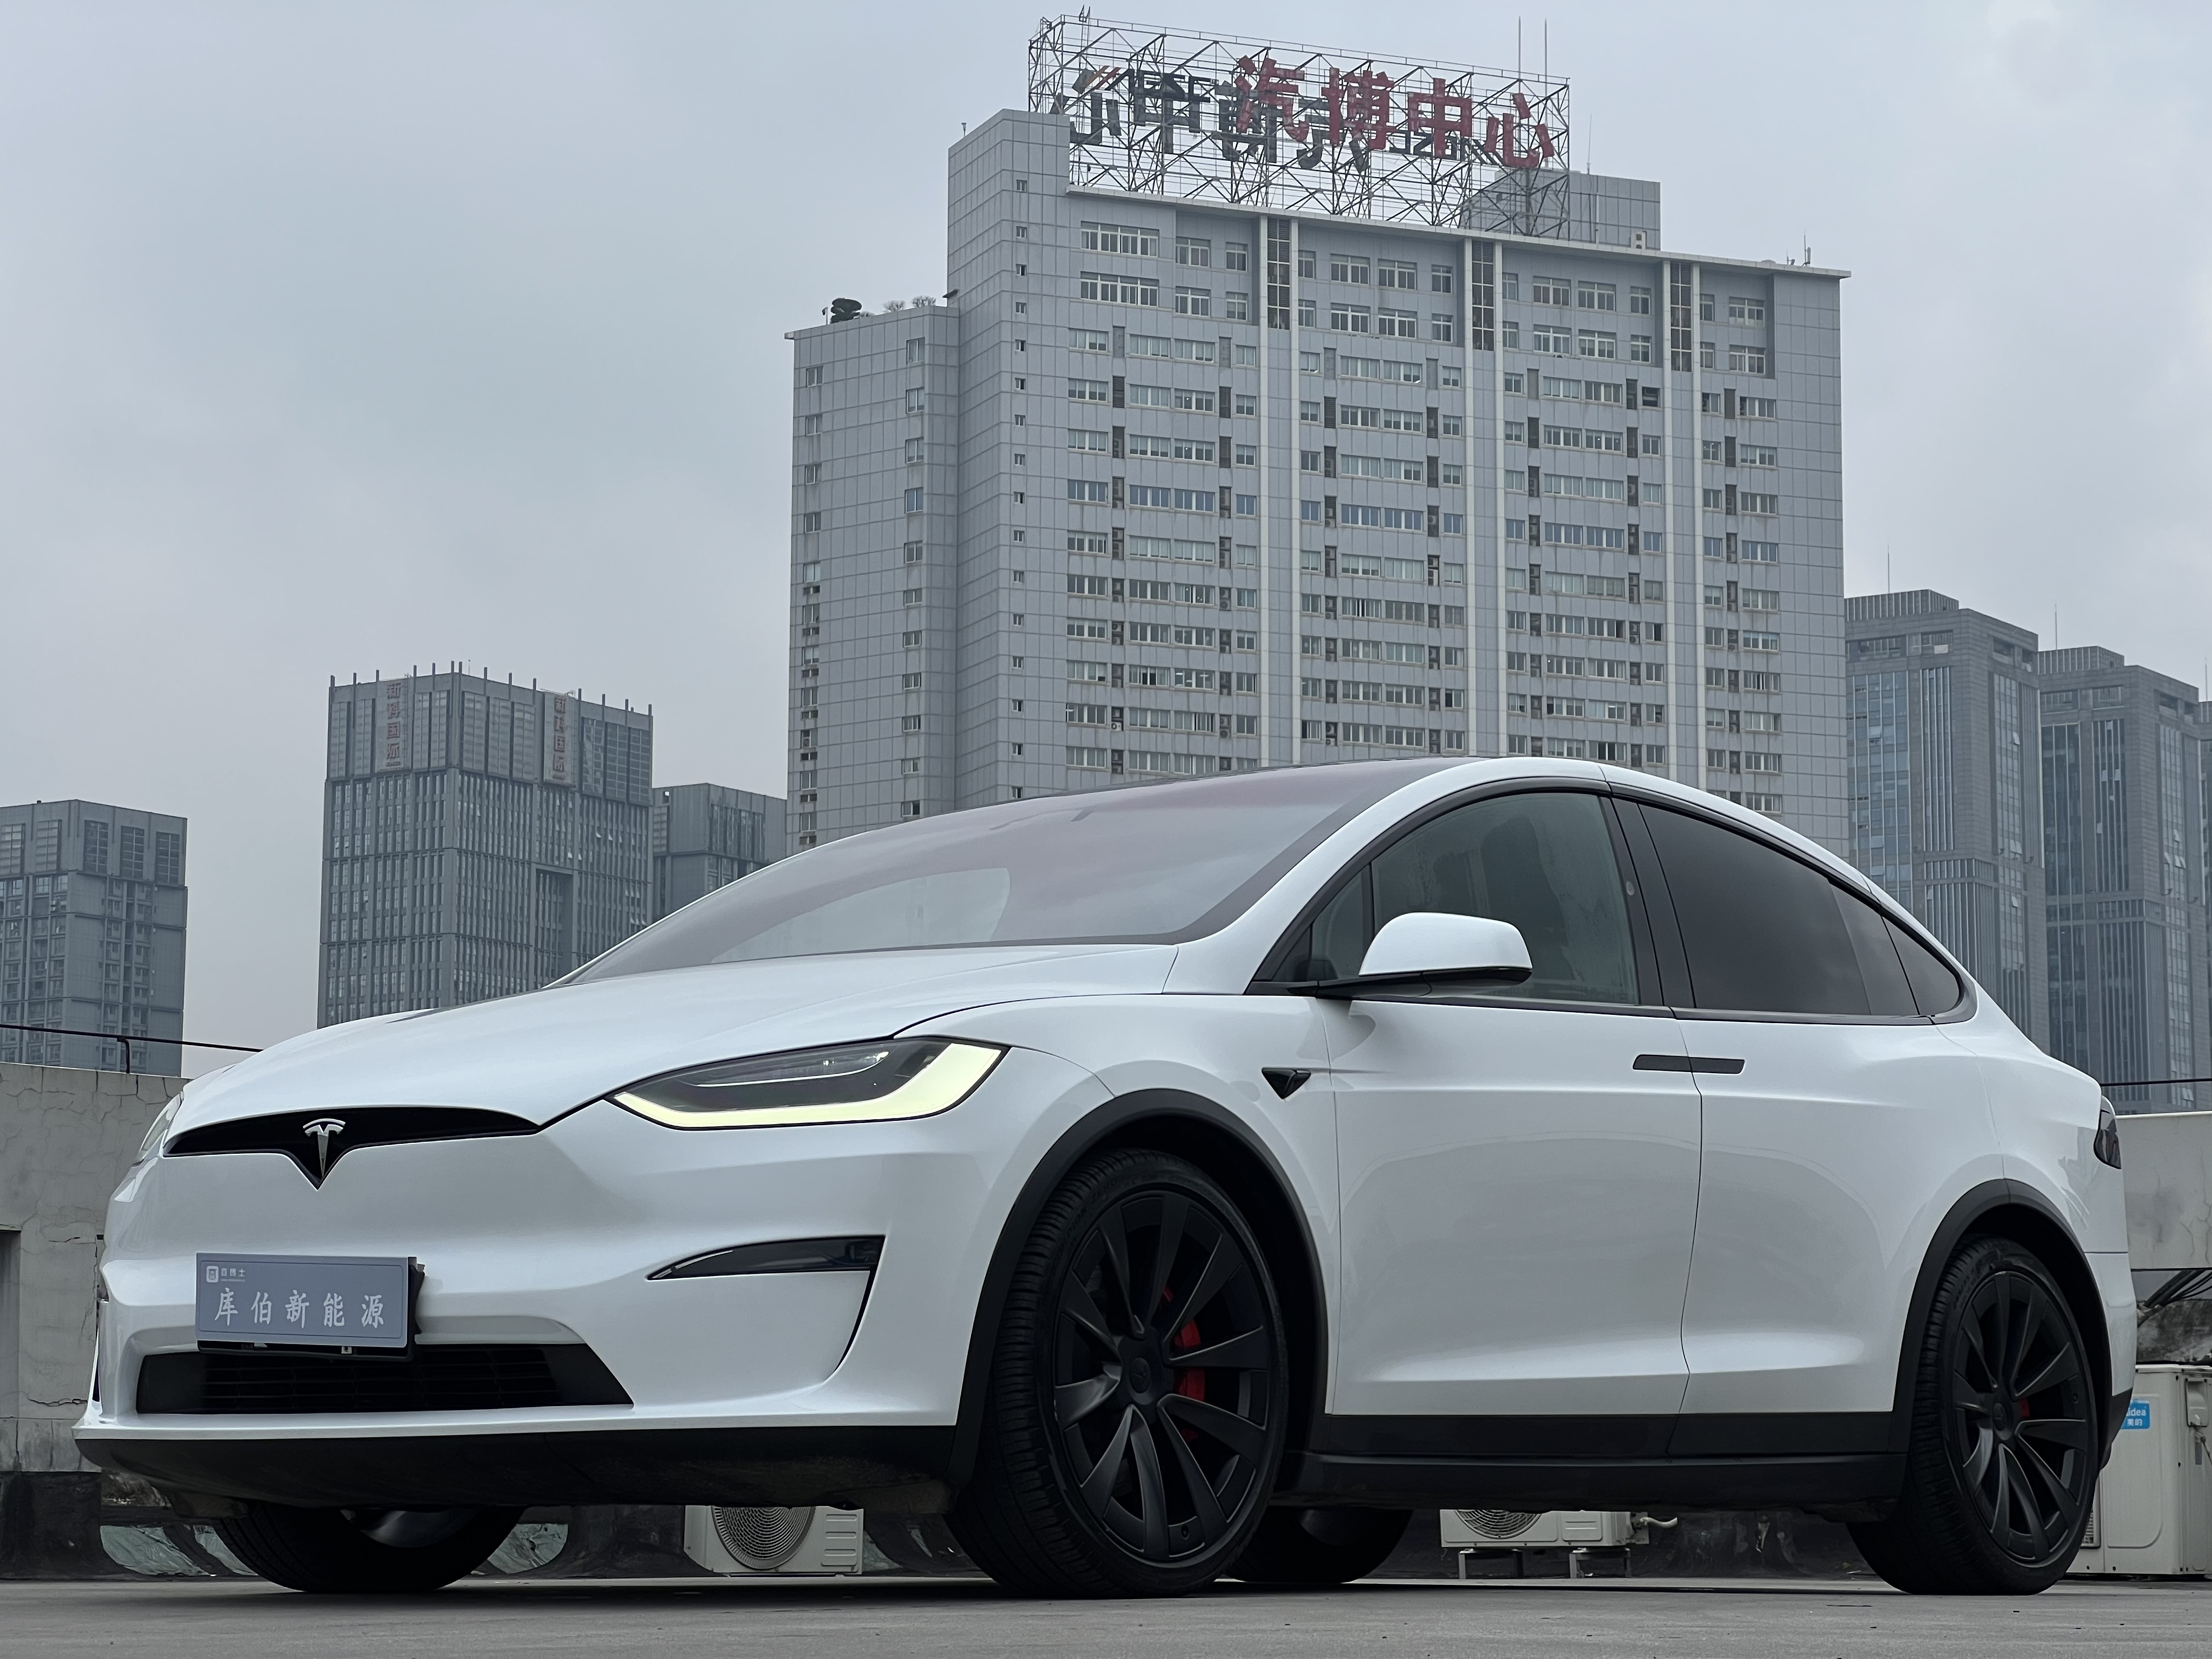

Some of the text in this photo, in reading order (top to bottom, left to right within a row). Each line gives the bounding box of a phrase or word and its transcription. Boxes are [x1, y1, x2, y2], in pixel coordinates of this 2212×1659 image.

[1234, 55, 1554, 168] 汽博中心
[215, 1287, 384, 1329] 库伯新能源
[2126, 1408, 2146, 1417] idea
